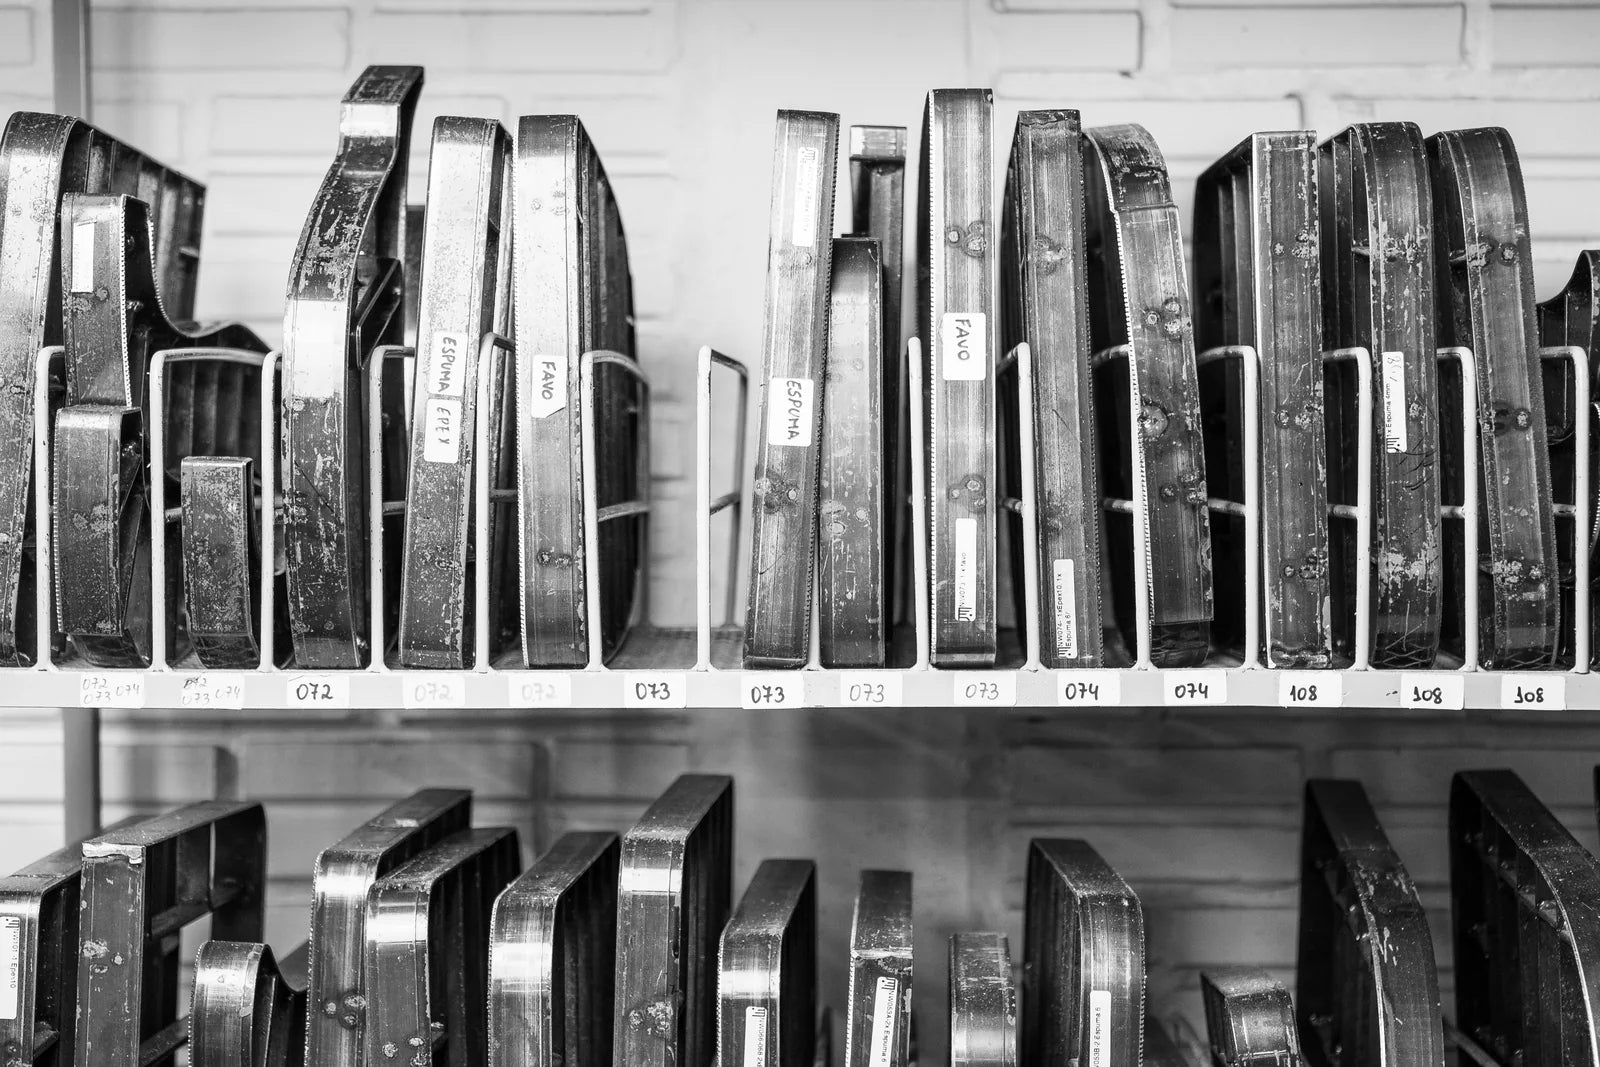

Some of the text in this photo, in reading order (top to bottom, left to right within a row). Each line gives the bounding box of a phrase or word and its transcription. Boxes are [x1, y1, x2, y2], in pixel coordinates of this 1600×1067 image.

[954, 318, 972, 361] FAVO
[437, 336, 458, 393] ESPUMA
[541, 361, 557, 400] FAVO
[786, 380, 803, 440] ESPUMA
[82, 678, 108, 689] 072
[296, 683, 334, 701] 072
[414, 683, 453, 702] 072
[522, 682, 557, 702] 072
[635, 682, 671, 701] 073
[849, 683, 884, 703] 073
[965, 682, 999, 700] 073
[1065, 682, 1099, 701] 074
[1174, 682, 1208, 699] 074
[751, 685, 785, 703] 073
[1289, 685, 1318, 702] 108
[1413, 685, 1442, 704] 108
[1514, 685, 1544, 704] 108
[882, 1030, 890, 1057] Espuma
